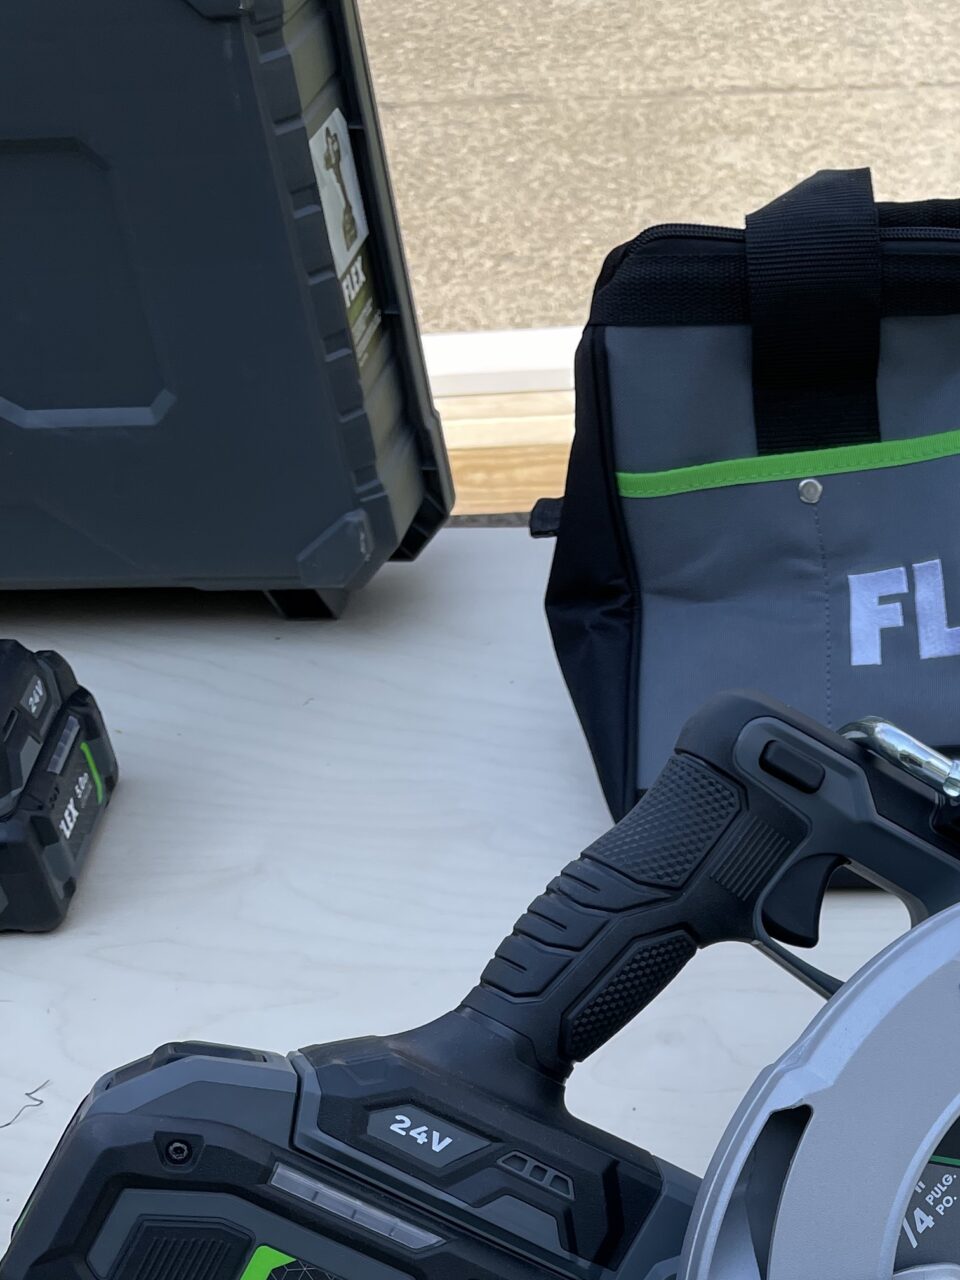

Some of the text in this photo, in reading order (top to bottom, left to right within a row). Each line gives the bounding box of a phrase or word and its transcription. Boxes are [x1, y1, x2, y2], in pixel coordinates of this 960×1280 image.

[342, 255, 366, 308] FLEX
[389, 1114, 453, 1153] 24V
[925, 1174, 957, 1206] PULG.
[935, 1196, 957, 1216] PO.
